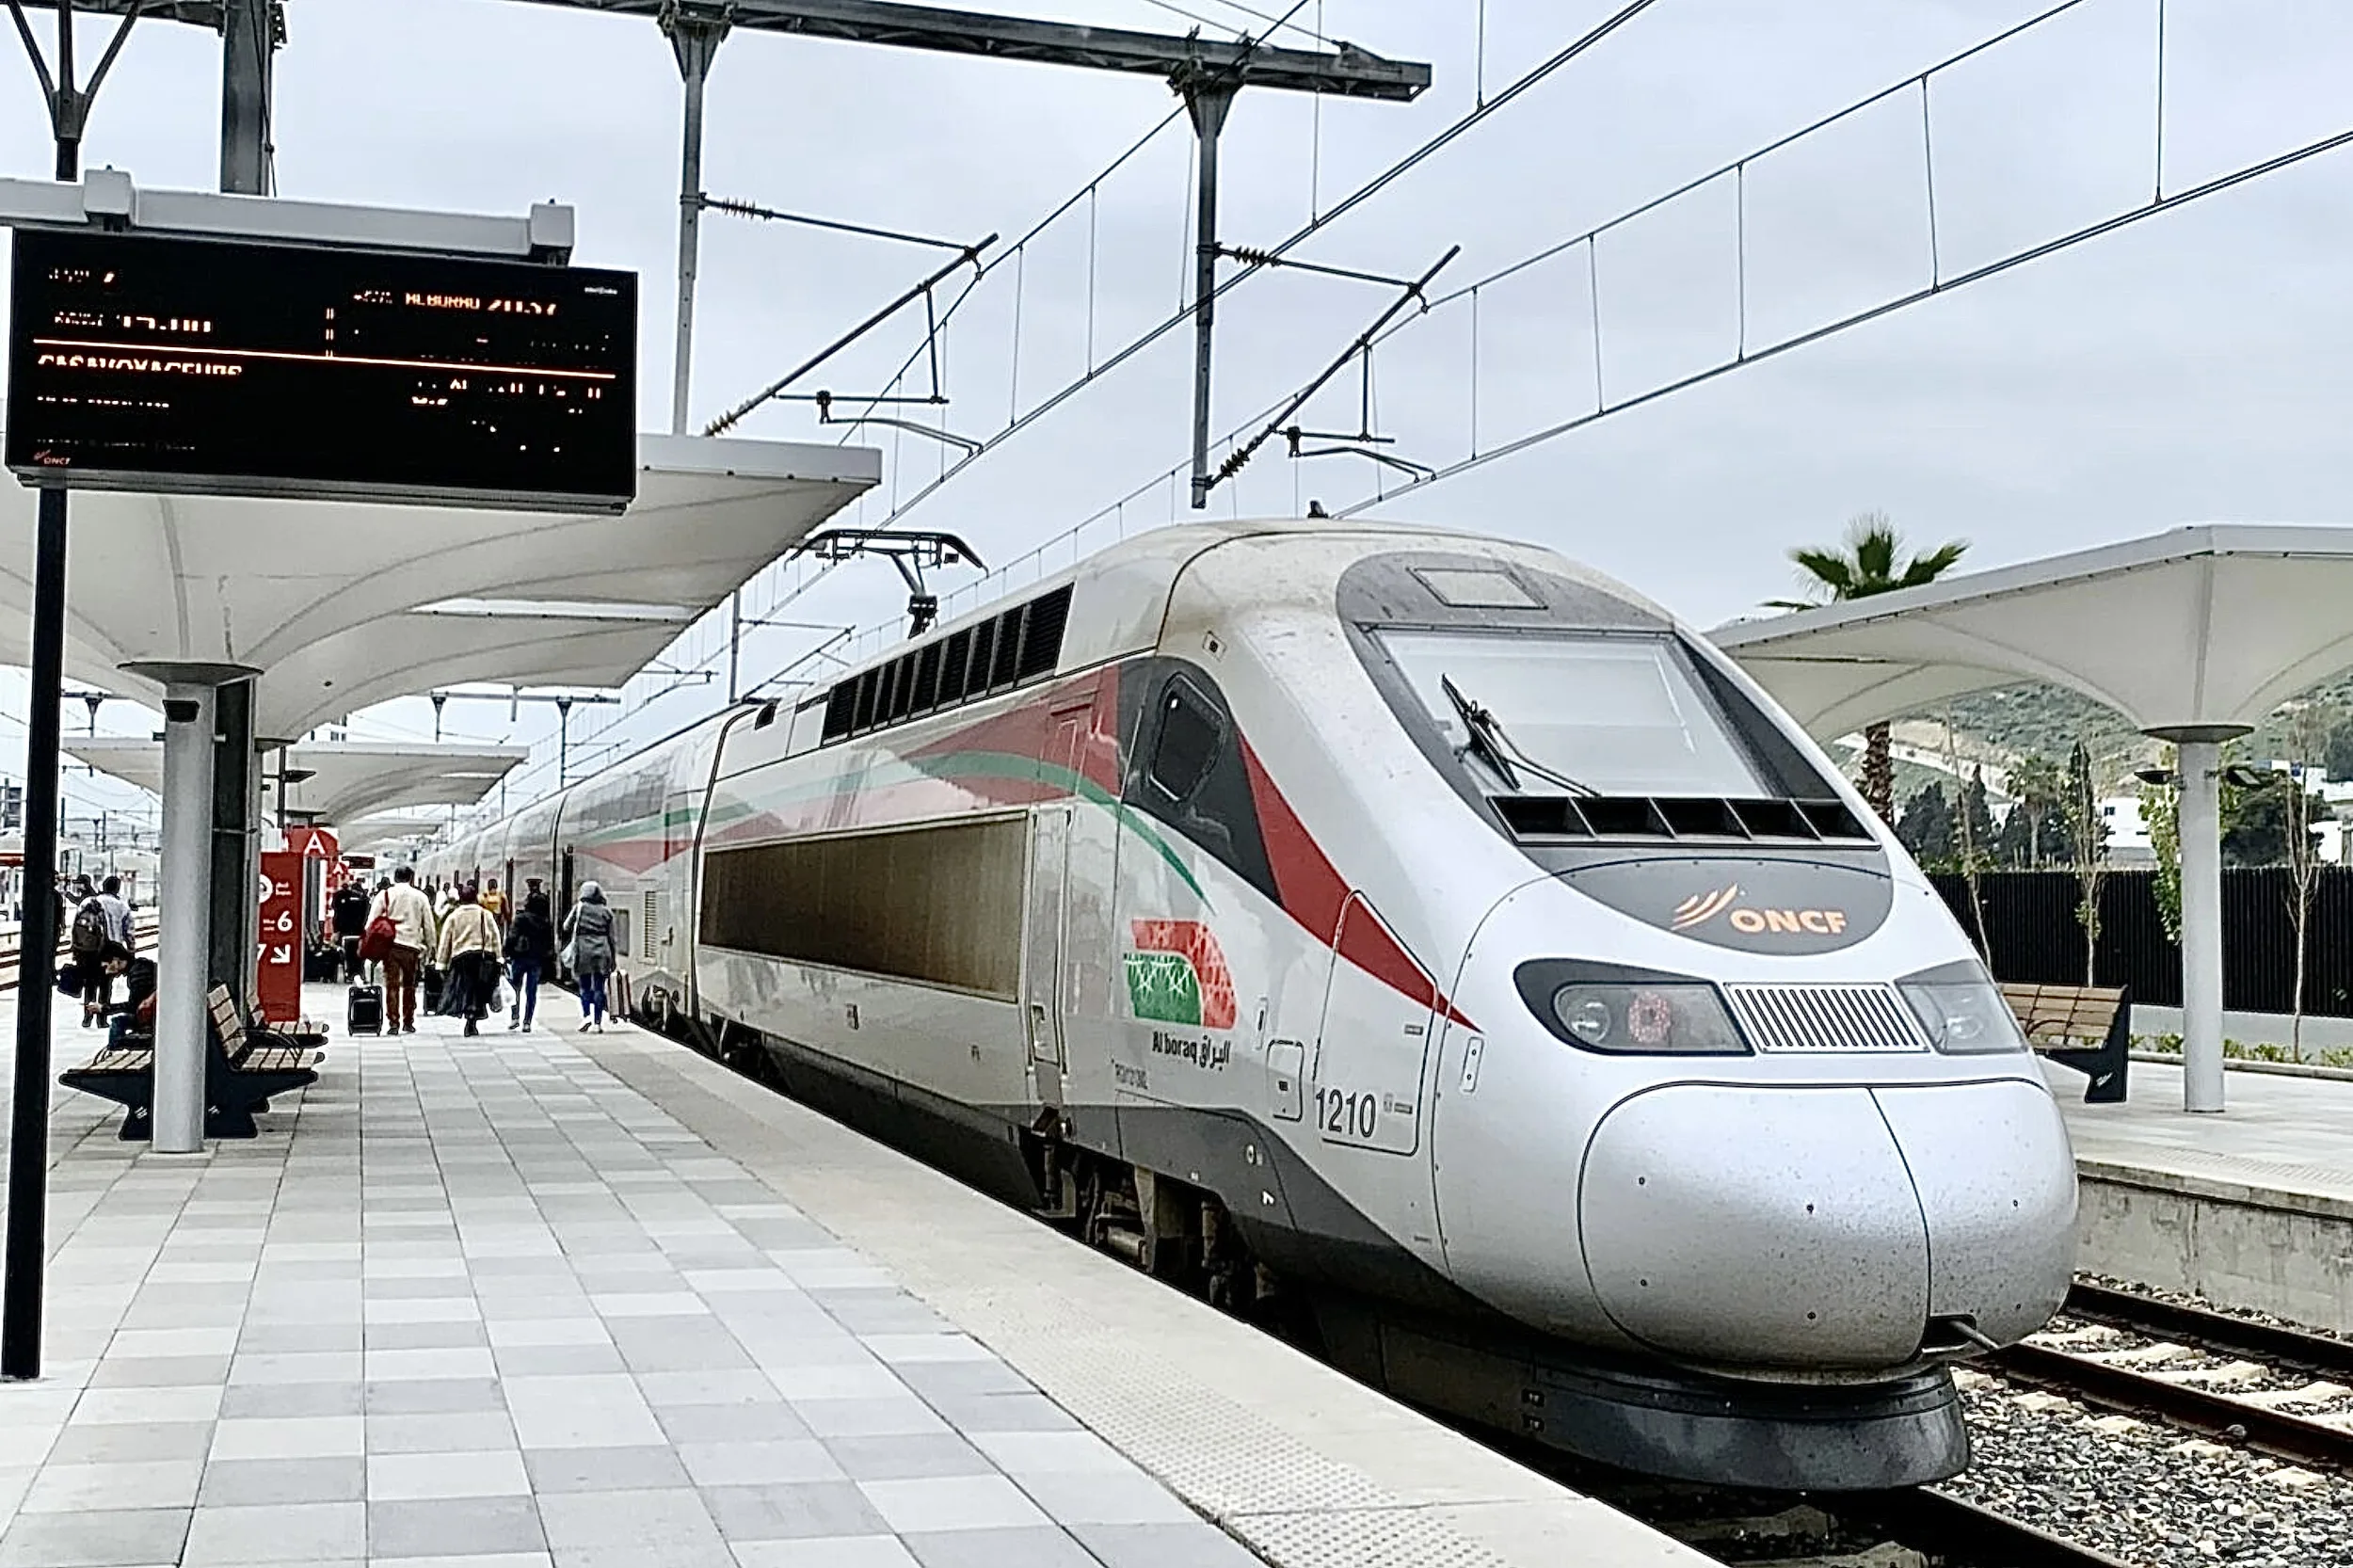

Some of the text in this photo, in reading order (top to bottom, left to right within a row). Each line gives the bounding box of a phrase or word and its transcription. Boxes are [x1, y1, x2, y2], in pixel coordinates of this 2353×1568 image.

[304, 831, 326, 855] A
[277, 910, 293, 932] 6
[1729, 908, 1847, 934] ONCF
[1163, 1032, 1197, 1064] boraq
[1315, 1087, 1377, 1138] 1210
